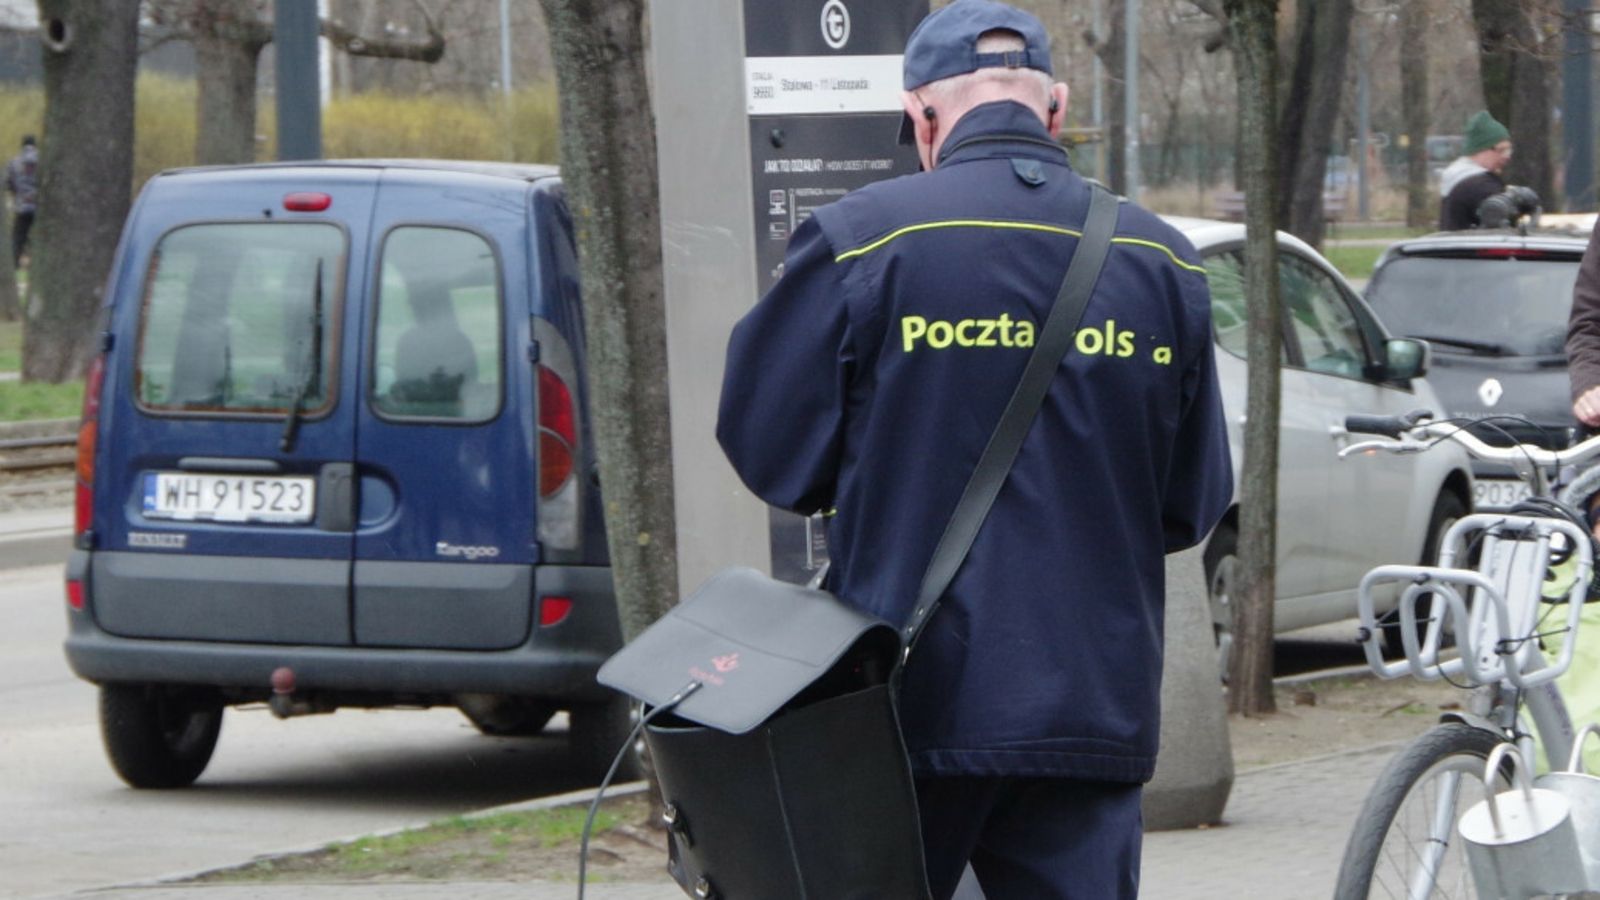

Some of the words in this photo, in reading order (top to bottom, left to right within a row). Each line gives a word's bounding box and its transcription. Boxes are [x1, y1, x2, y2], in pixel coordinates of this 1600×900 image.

[901, 313, 1036, 353] Poczta
[1073, 319, 1173, 366] olsa
[164, 478, 203, 508] WH
[213, 479, 305, 512] 91523
